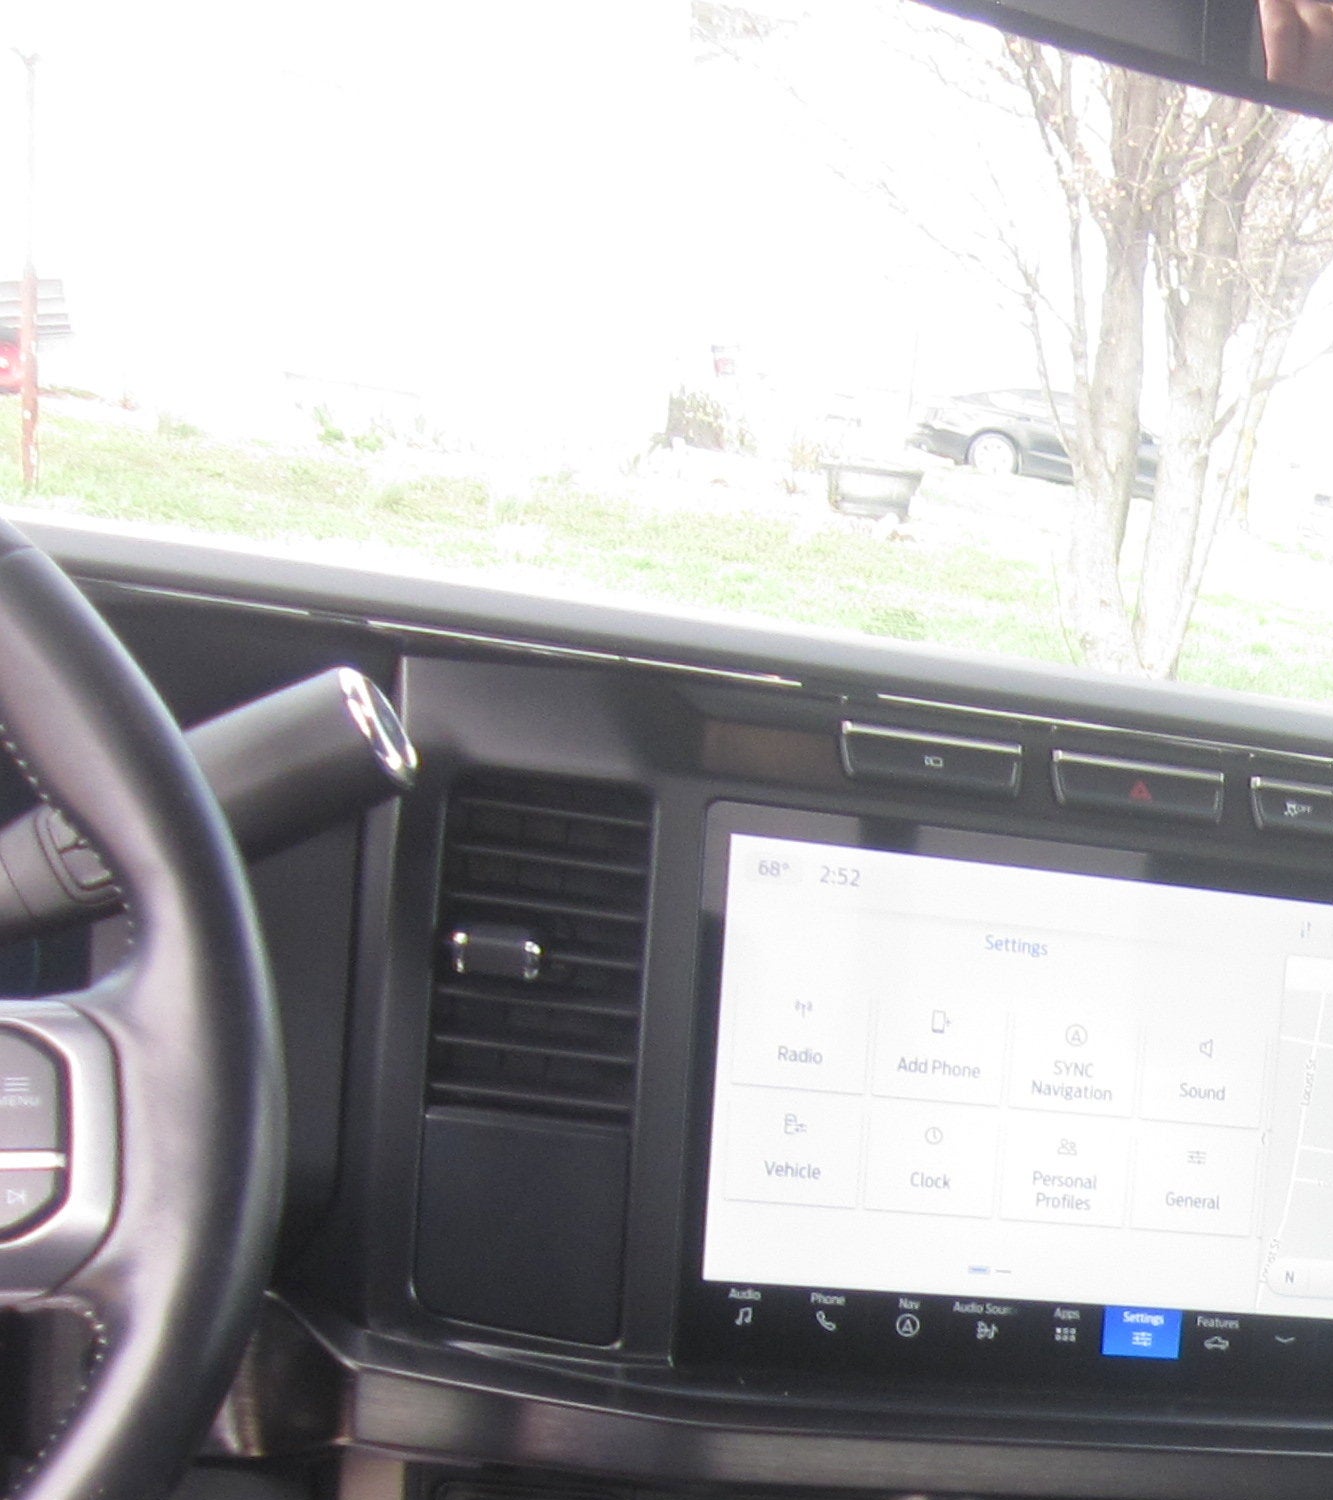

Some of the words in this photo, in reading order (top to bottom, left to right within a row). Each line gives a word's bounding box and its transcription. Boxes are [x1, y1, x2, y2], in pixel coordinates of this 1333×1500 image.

[819, 865, 861, 888] 2:52
[984, 934, 1048, 957] Settings
[777, 1045, 823, 1066] Radio
[897, 1057, 928, 1076] Add
[931, 1059, 981, 1079] Phone
[1053, 1060, 1094, 1079] SYNC
[1031, 1079, 1112, 1103] Navigation
[1179, 1082, 1226, 1102] Sound
[764, 1160, 821, 1181] Vehicle
[910, 1171, 951, 1190] Clock
[1032, 1171, 1097, 1191] Personal
[1035, 1192, 1091, 1212] Profiles
[1165, 1191, 1220, 1211] General
[1285, 1270, 1295, 1284] N
[728, 1287, 762, 1301] Audio
[810, 1292, 845, 1307] Phone
[899, 1298, 921, 1311] Nav
[953, 1300, 983, 1314] Audio
[1054, 1307, 1081, 1321] Apps
[1122, 1309, 1165, 1327] Settings
[1197, 1315, 1240, 1330] Features
